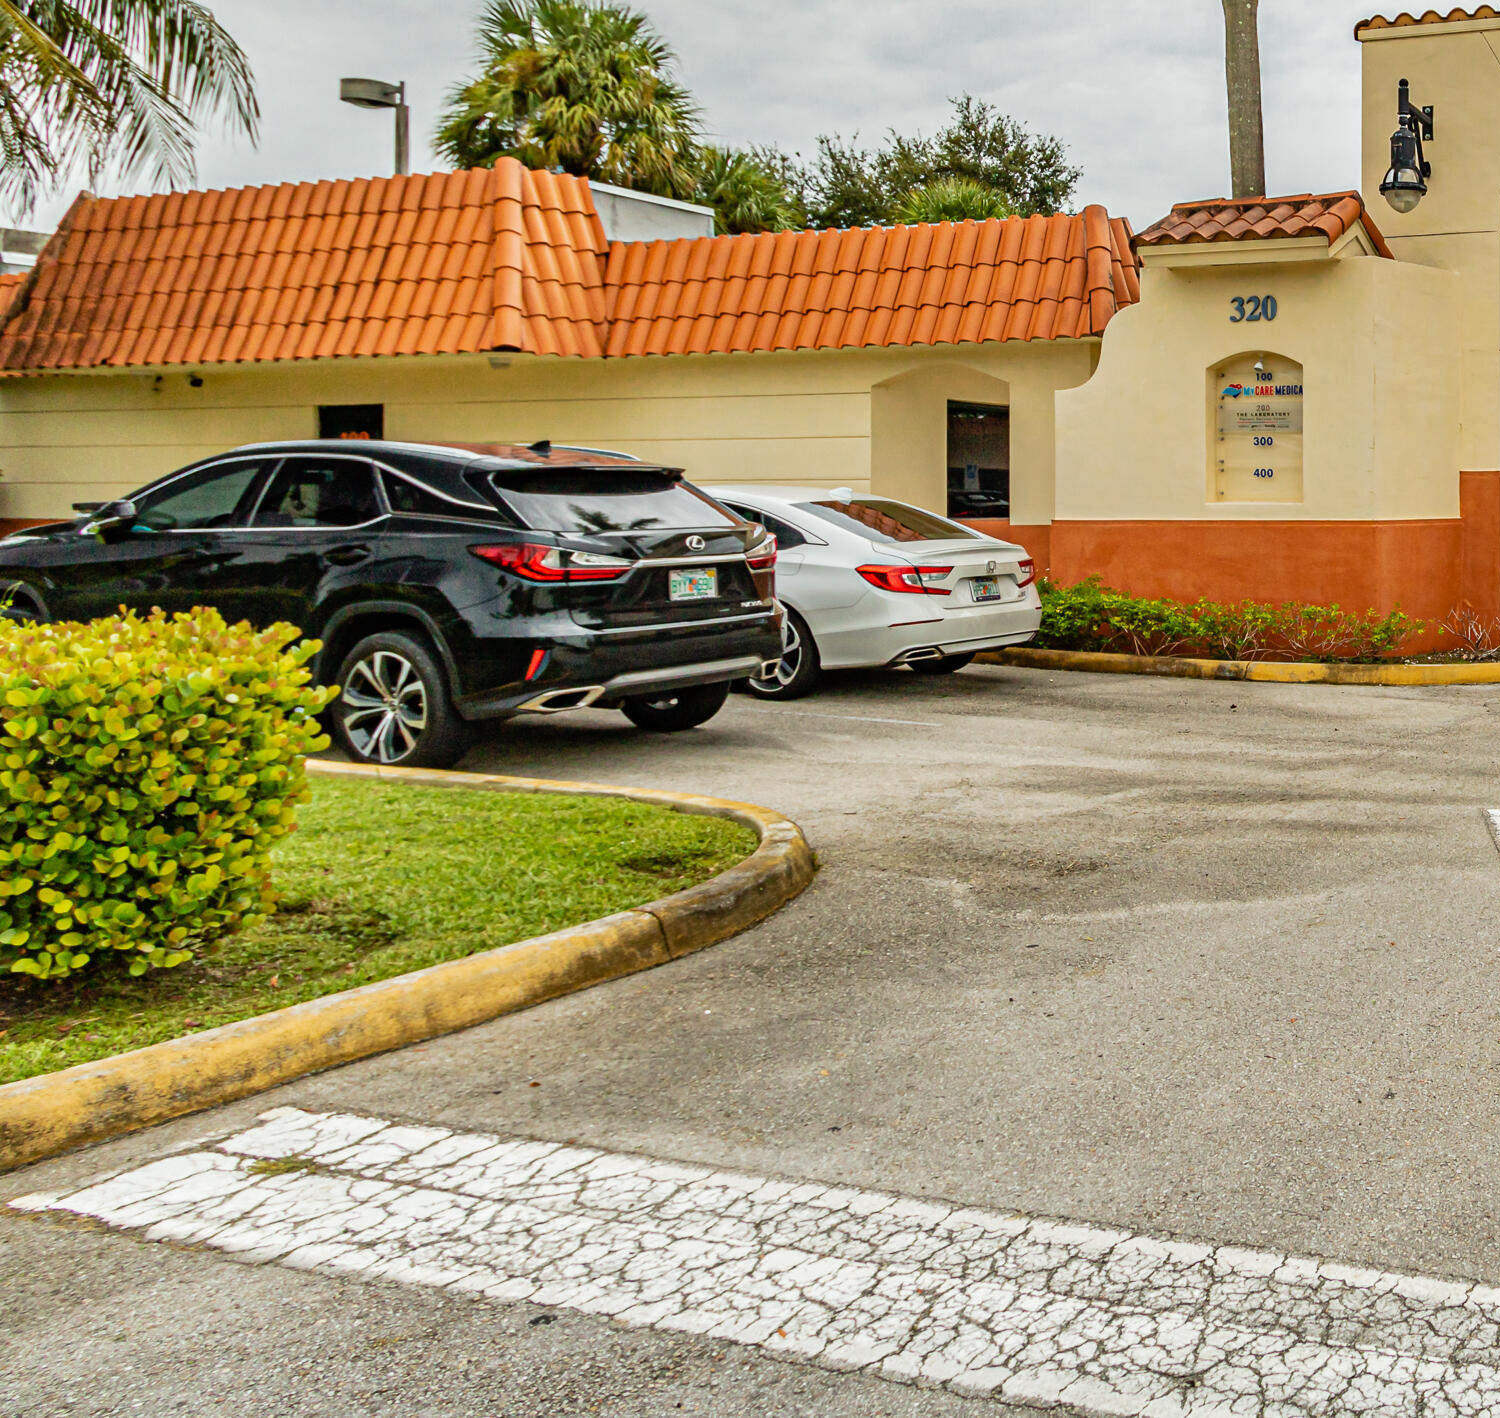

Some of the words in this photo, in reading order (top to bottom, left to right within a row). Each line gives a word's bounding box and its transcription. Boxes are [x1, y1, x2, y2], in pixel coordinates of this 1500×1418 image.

[1229, 294, 1278, 323] 320
[1256, 372, 1273, 381] 100
[1253, 436, 1273, 446] 300
[1253, 468, 1274, 478] 400
